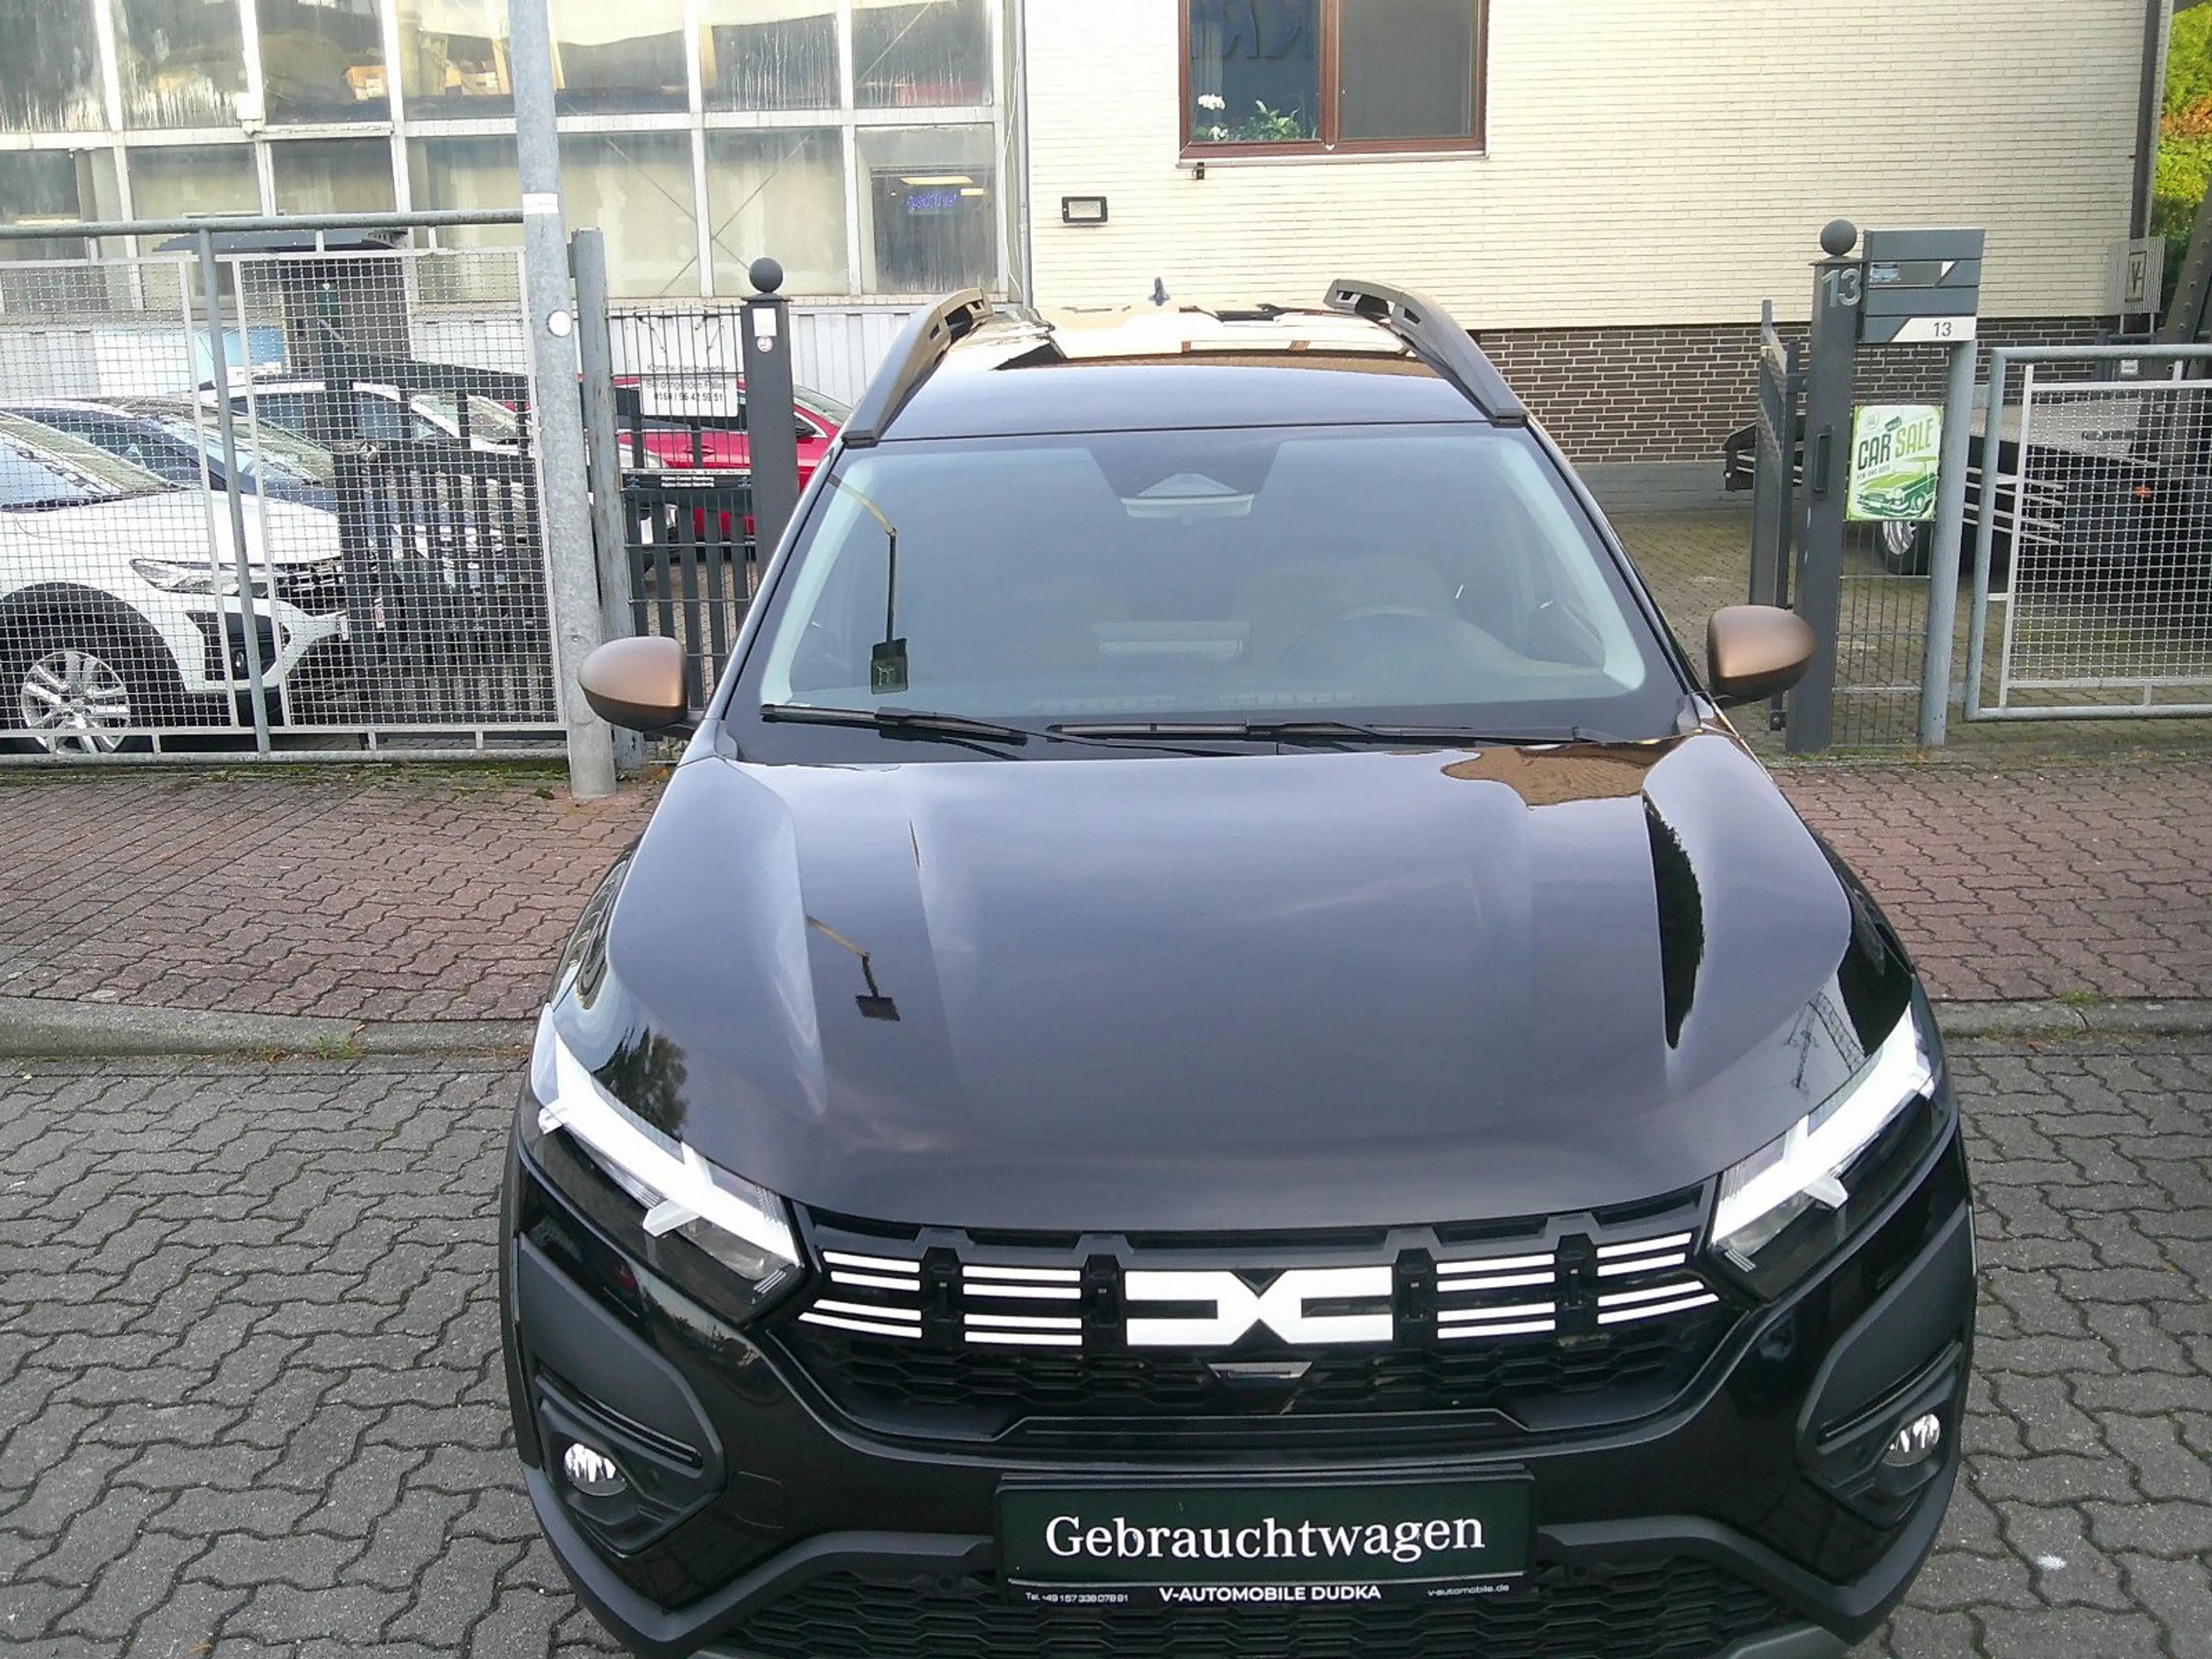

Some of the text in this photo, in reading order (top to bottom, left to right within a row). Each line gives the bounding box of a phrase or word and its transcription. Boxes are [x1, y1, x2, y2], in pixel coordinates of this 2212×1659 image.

[1822, 268, 1862, 308] 13
[1933, 321, 1952, 337] 13
[1858, 434, 1891, 470] CAR
[1895, 418, 1934, 458] SALE
[1045, 1515, 1486, 1563] Gebrauchtwagen
[1158, 1585, 1382, 1602] V-AUTOMOBILE DUDKA
